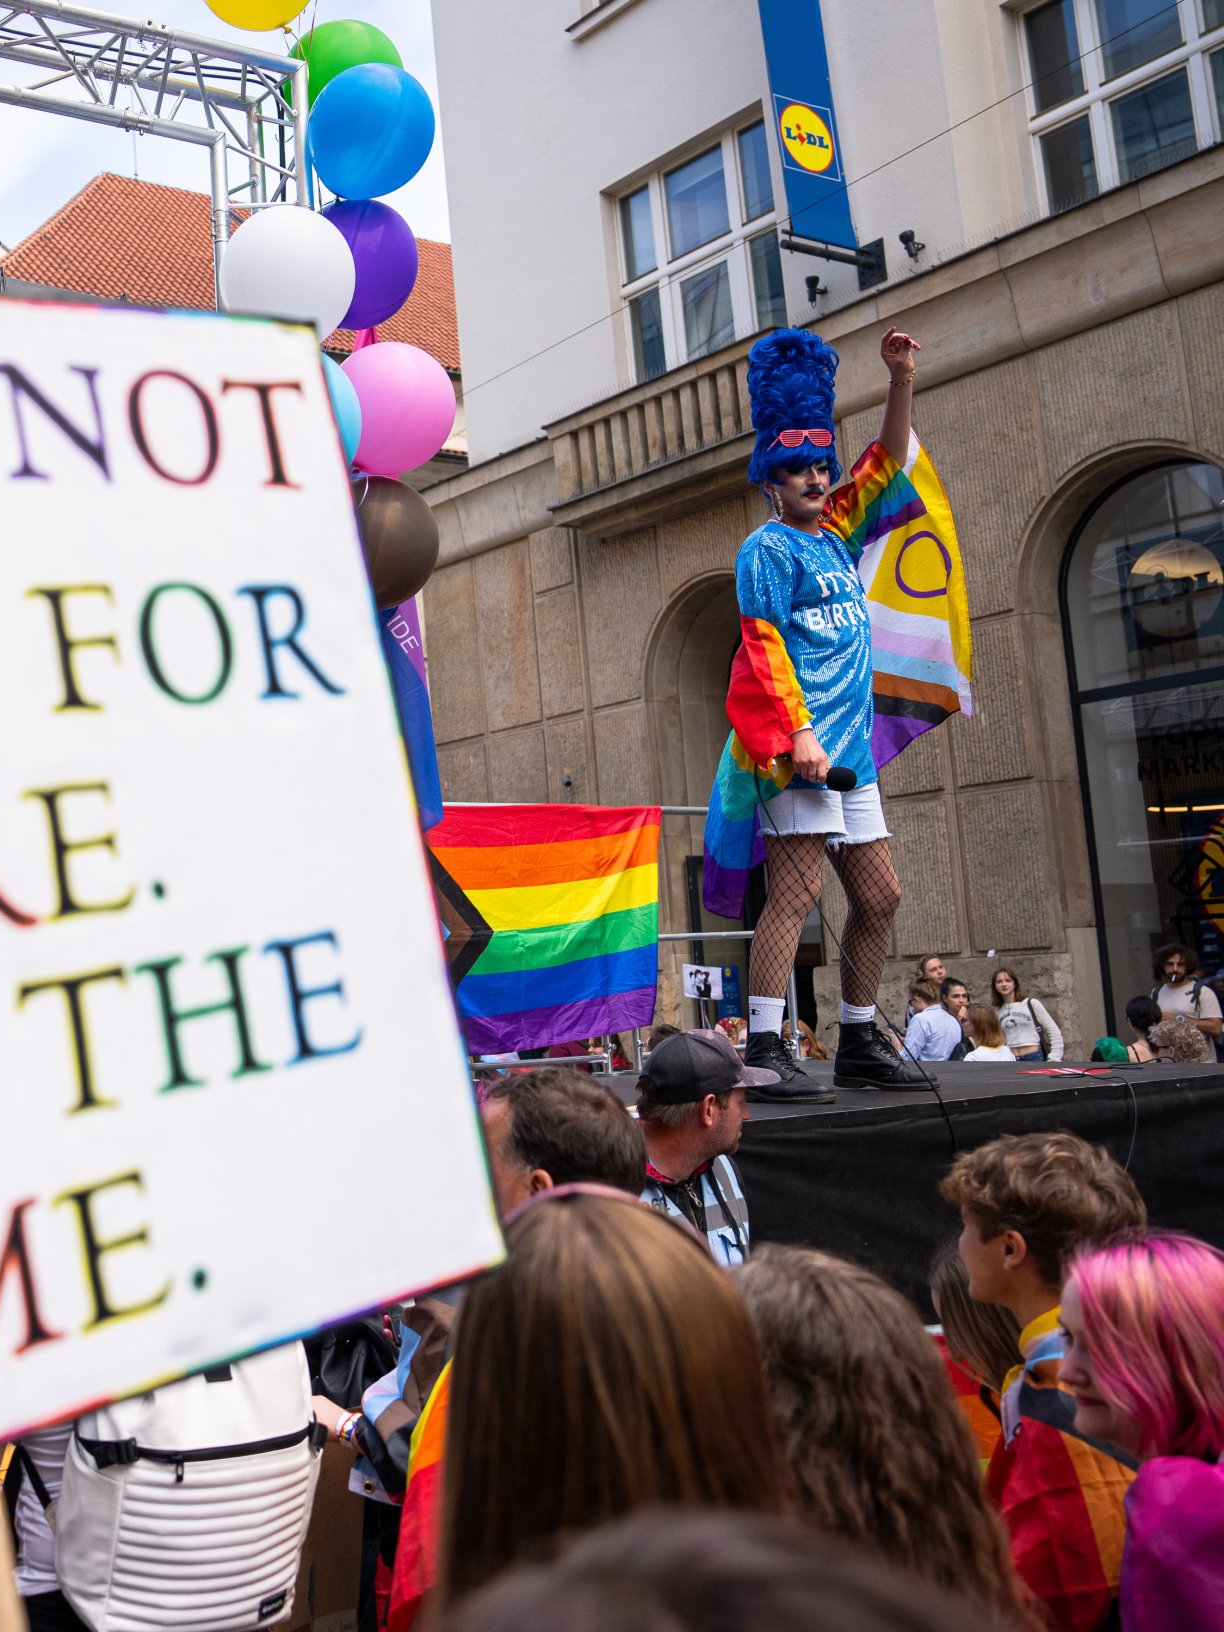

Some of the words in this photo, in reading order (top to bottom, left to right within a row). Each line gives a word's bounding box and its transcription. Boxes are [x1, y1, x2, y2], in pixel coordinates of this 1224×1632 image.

[784, 123, 830, 150] LIDL
[23, 581, 348, 716] FOR
[14, 928, 364, 1118] THE
